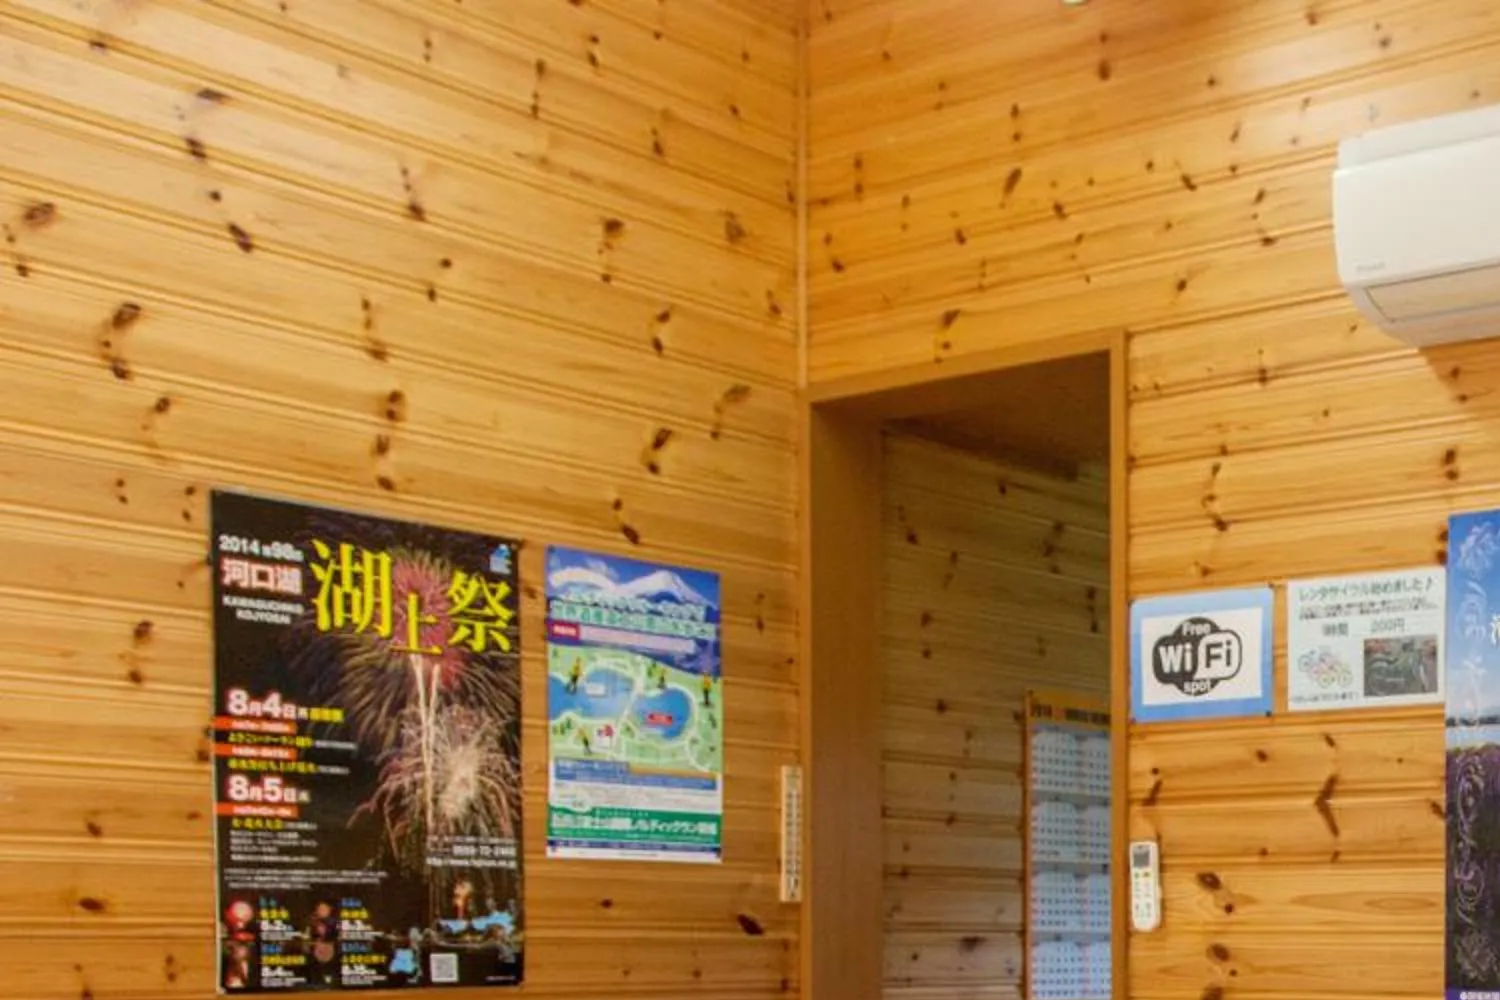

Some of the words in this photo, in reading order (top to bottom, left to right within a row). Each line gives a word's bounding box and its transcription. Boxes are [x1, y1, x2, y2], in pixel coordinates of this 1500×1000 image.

[221, 556, 303, 595] 河口湖
[309, 537, 515, 654] 湖上祭
[1181, 622, 1213, 637] Free
[1183, 678, 1213, 697] spot
